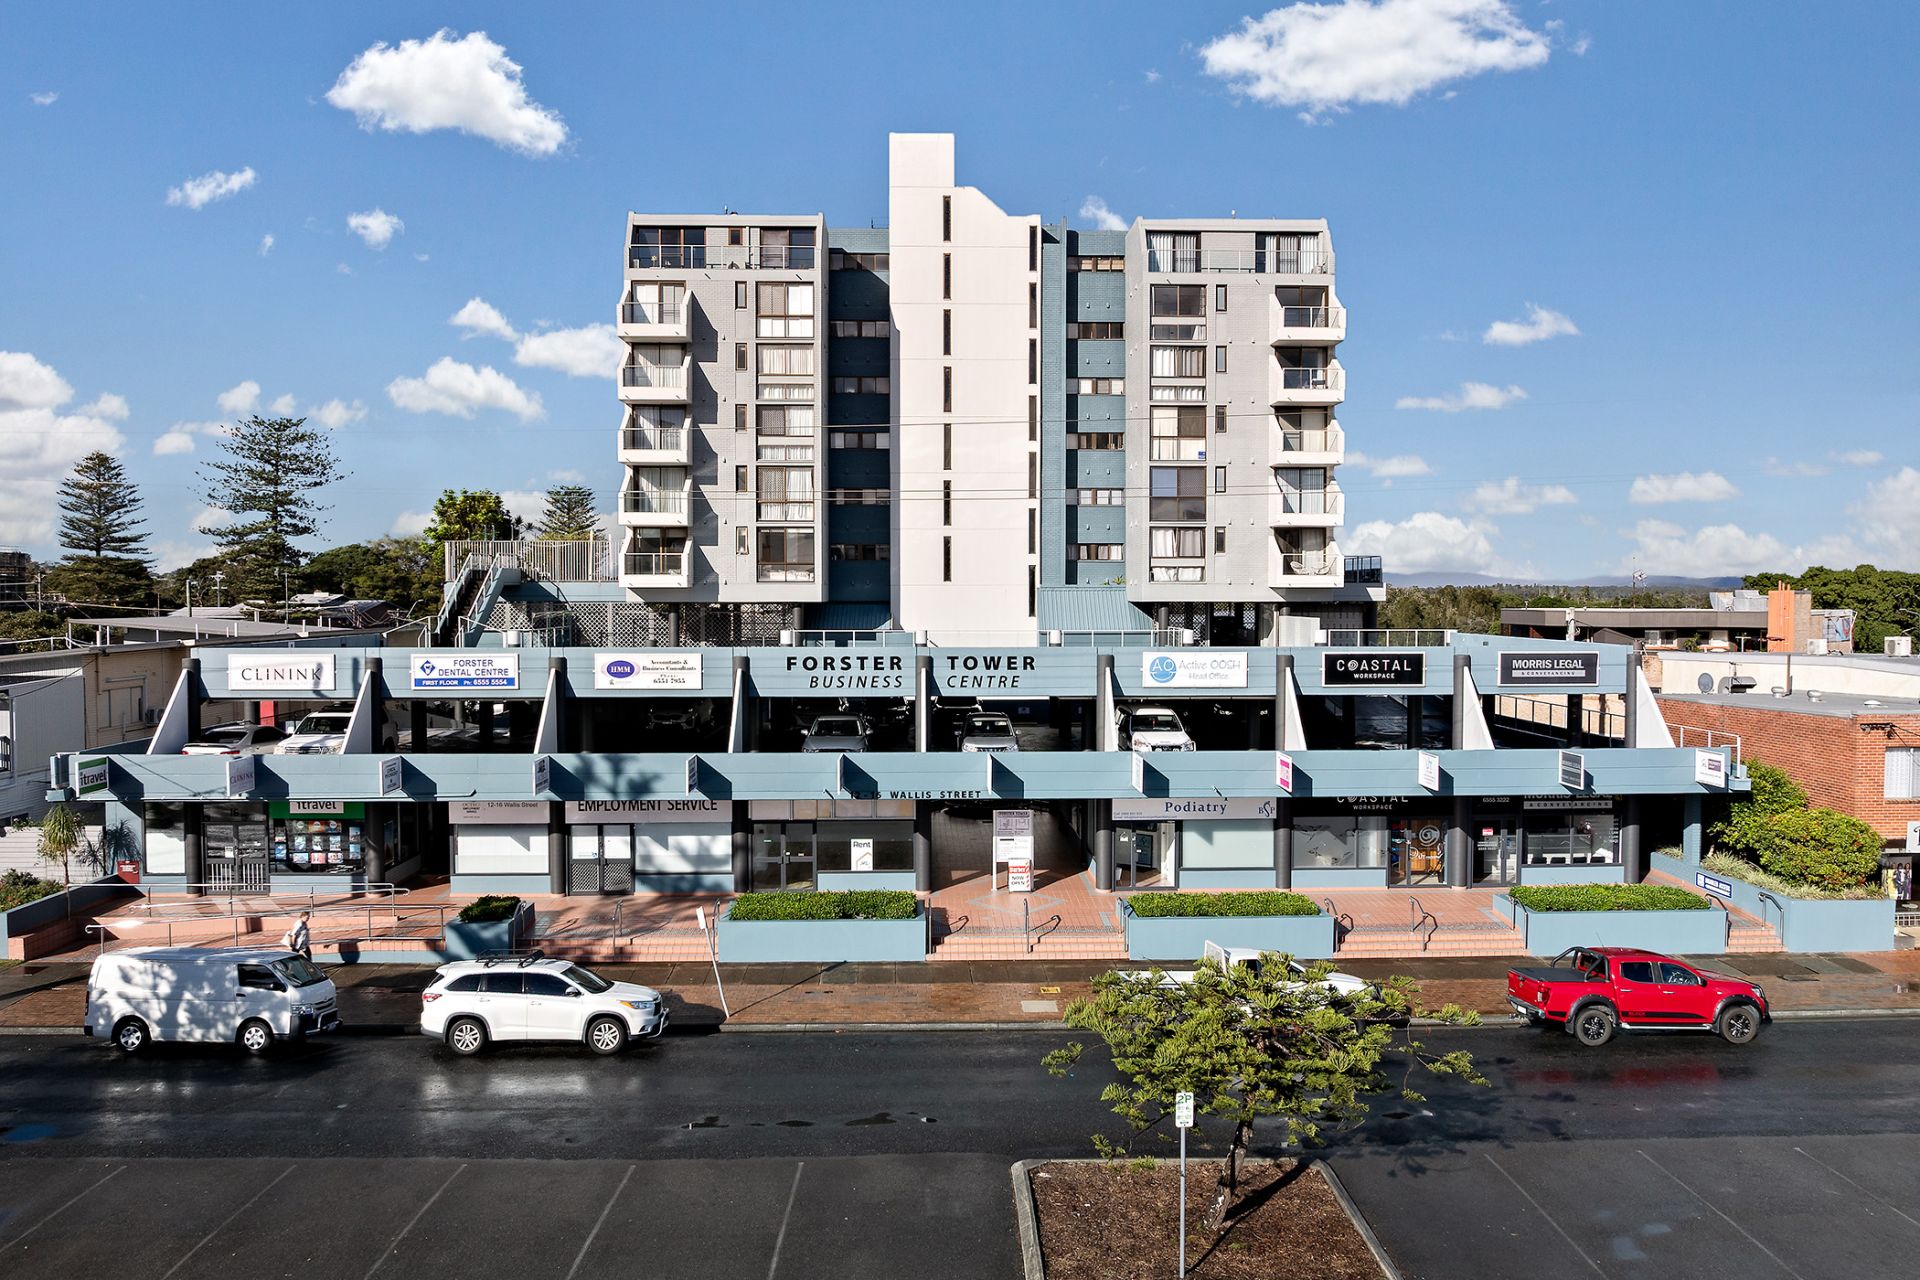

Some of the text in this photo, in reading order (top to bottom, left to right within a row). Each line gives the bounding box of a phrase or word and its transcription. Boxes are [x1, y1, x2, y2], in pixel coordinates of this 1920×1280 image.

[453, 659, 493, 667] FORSTER
[786, 656, 903, 671] FORSTER
[946, 656, 1035, 670] TOWER
[1179, 660, 1241, 670] Active OOSH
[1336, 659, 1411, 671] COASTAL
[1512, 660, 1585, 669] MORRIS LEGAL
[241, 668, 321, 681] CLININK
[438, 668, 509, 676] DENTAL CENTRE
[809, 676, 903, 688] BUSINESS
[946, 675, 1020, 688] CENTRE
[80, 770, 107, 786] itravel
[890, 791, 932, 799] WALLIS
[940, 791, 981, 799] STREET
[578, 800, 718, 811] EMPLOYMENT SERVICE
[1165, 801, 1227, 815] Podiatry
[1177, 1095, 1192, 1104] 2P
